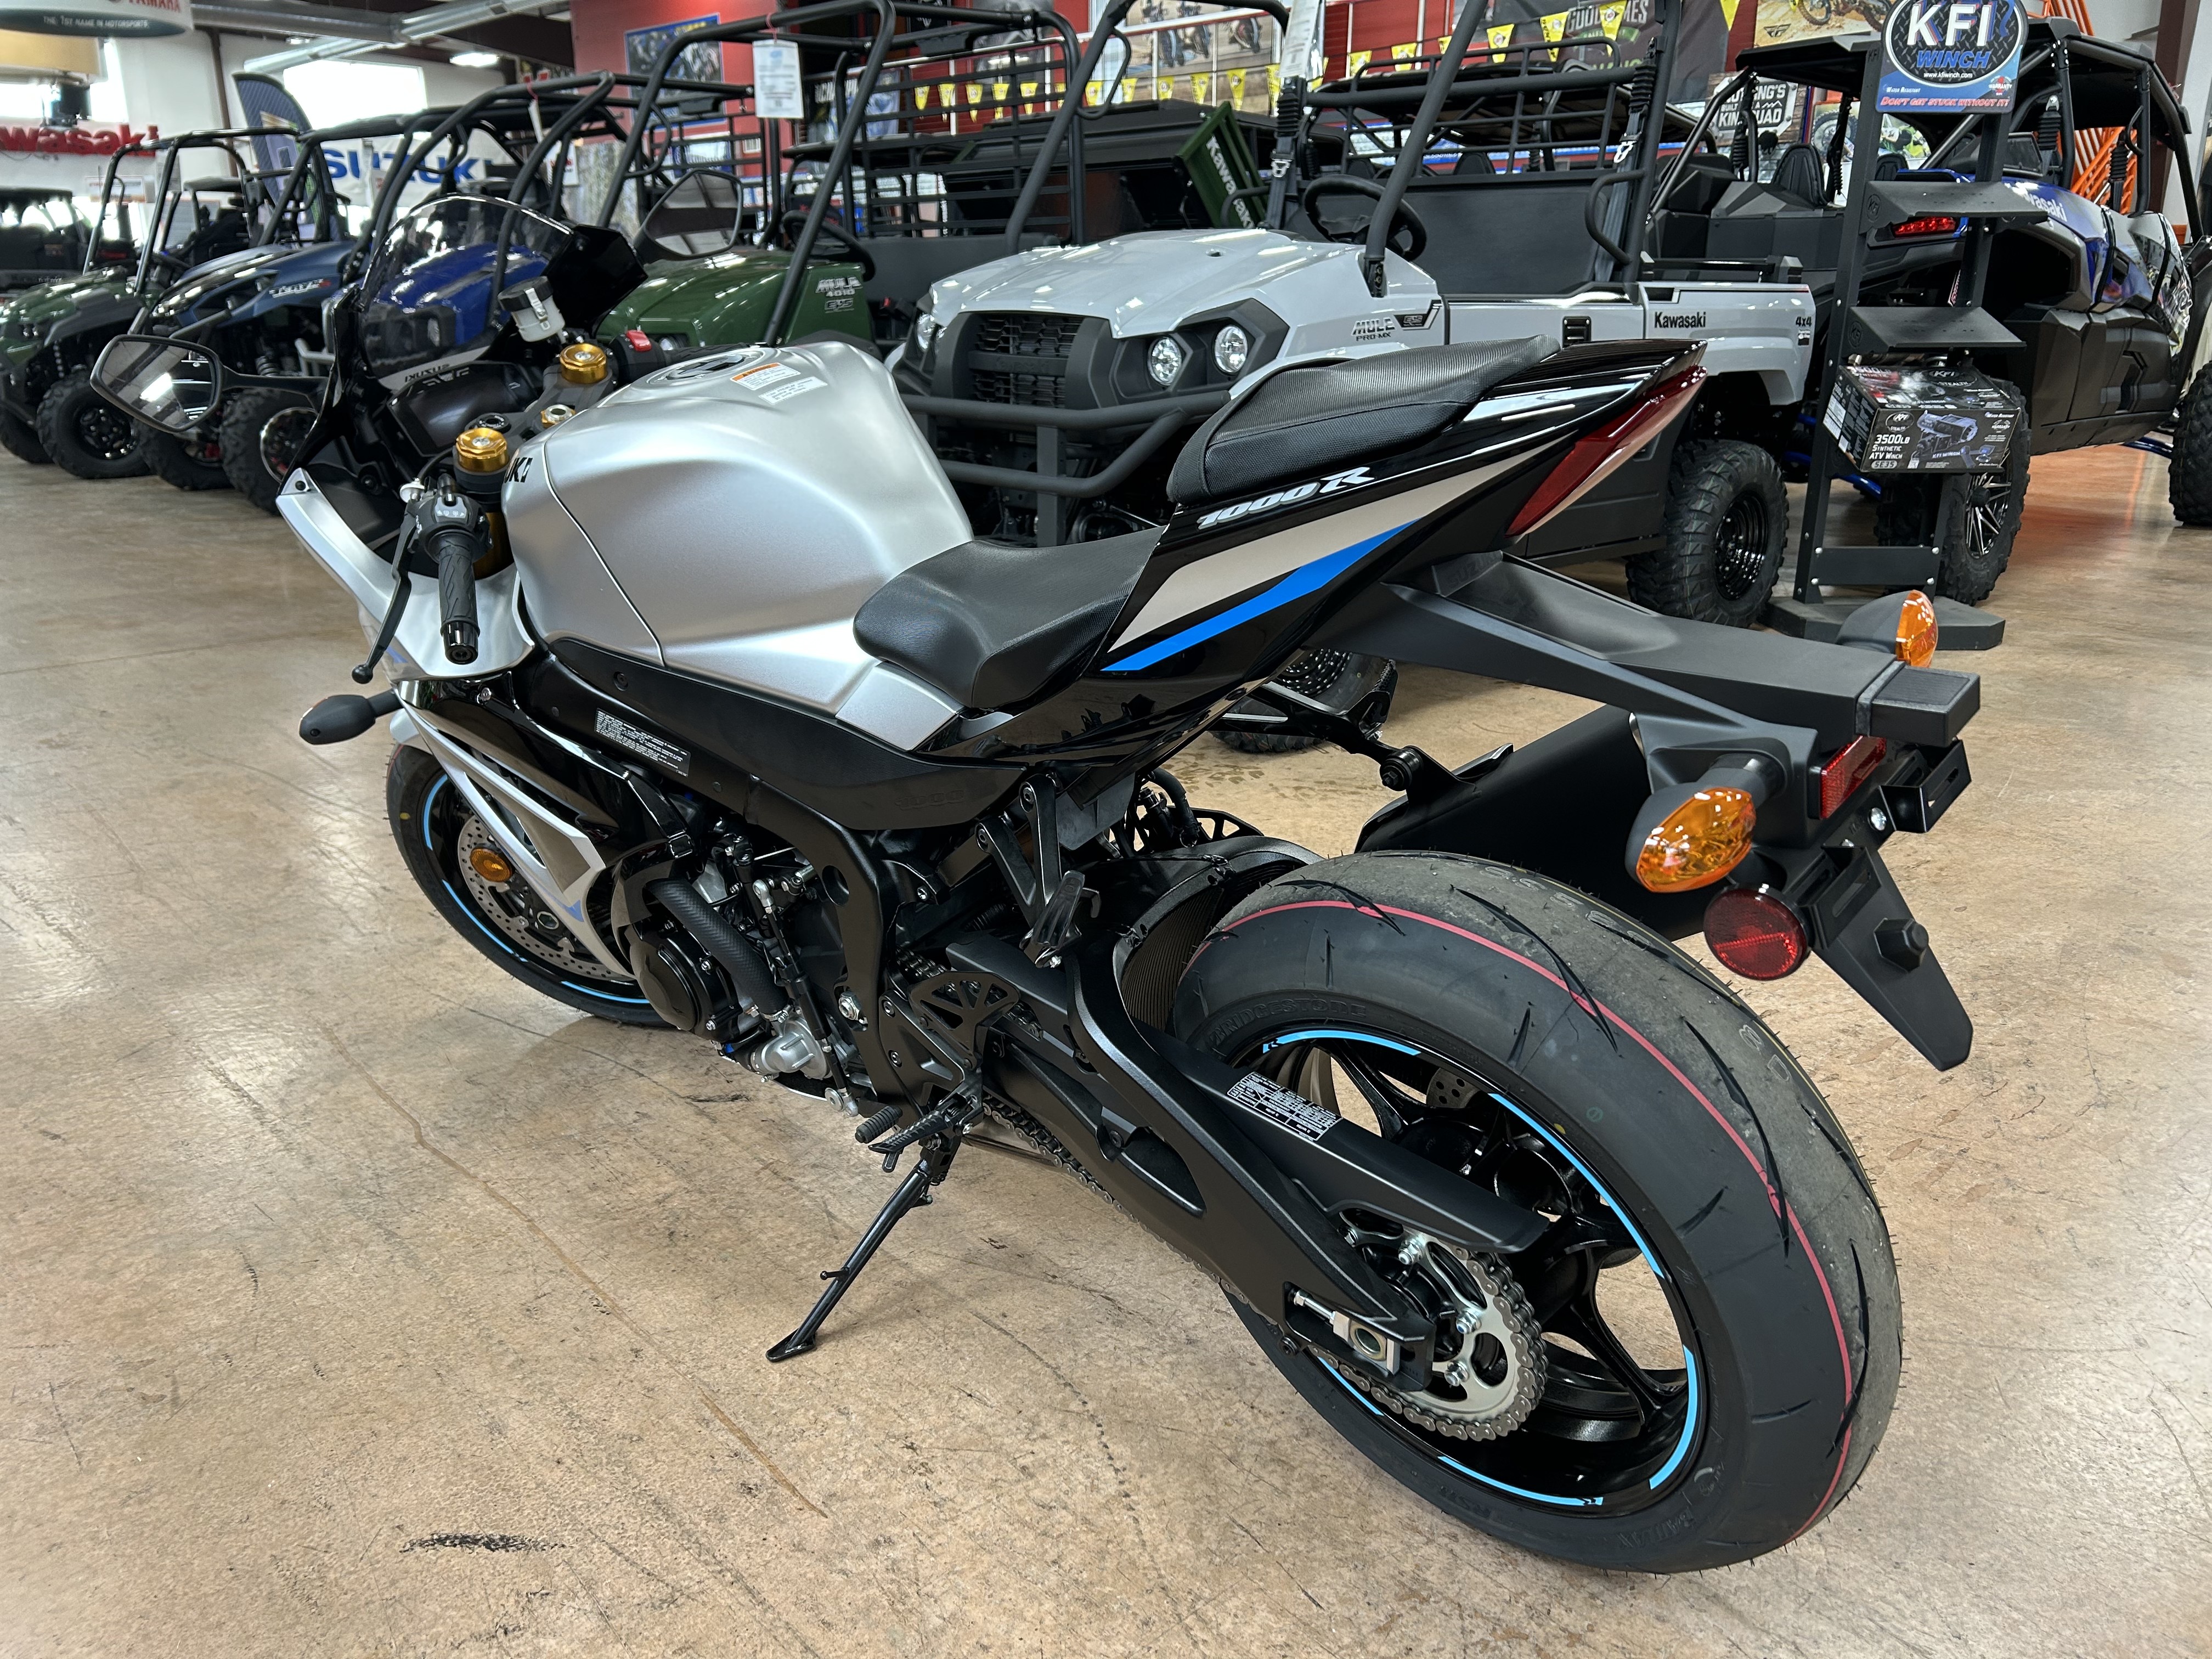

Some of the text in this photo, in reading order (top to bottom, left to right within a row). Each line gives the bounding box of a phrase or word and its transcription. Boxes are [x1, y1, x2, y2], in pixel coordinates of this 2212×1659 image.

[1907, 3, 1993, 46] KFI
[1916, 50, 1991, 69] WINCH
[1910, 98, 1927, 106] GET
[1928, 98, 1957, 106] STUCK
[1958, 98, 1996, 106] WITHOUT
[1718, 108, 1782, 128] KINUAD
[1206, 136, 1255, 229] Kawaak
[815, 276, 861, 294] MULE
[1351, 317, 1396, 335] MULE
[1655, 311, 1706, 328] Kawasaki
[1796, 316, 1812, 327] 4x4
[1356, 332, 1391, 342] PRO-MX
[1874, 434, 1911, 444] 3500LB
